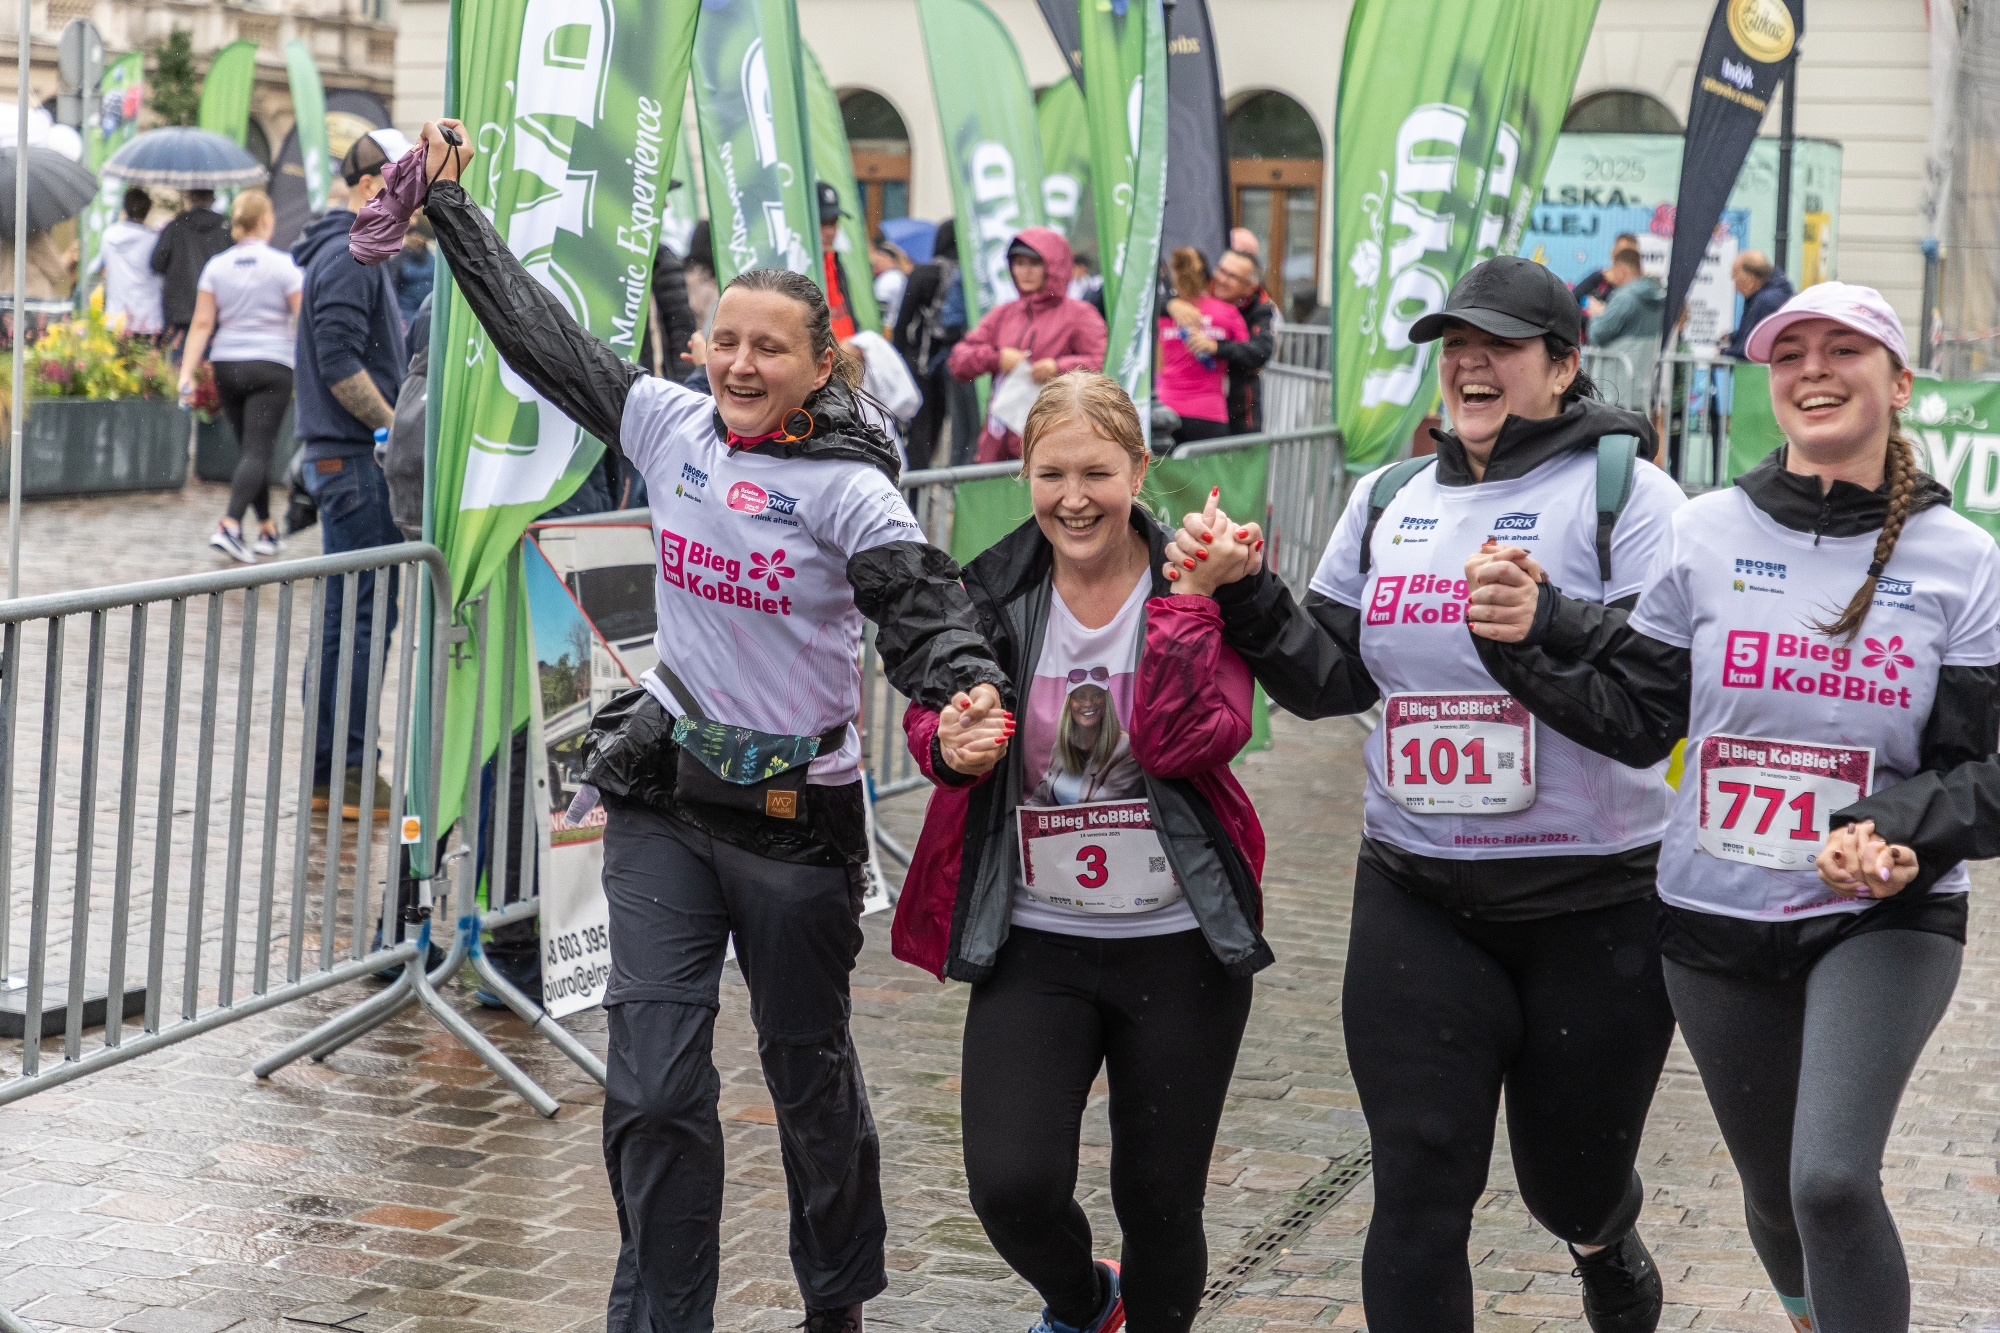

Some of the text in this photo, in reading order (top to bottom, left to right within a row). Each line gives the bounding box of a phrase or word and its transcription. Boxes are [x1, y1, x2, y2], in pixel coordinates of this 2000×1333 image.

[616, 96, 664, 257] Experience
[1583, 153, 1646, 183] 2025
[1361, 102, 1469, 408] LOYD
[767, 497, 795, 514] ORK
[772, 516, 800, 528] ahead.
[1496, 517, 1535, 528] TORK
[663, 536, 680, 568] 5
[687, 541, 741, 583] Bieg
[1735, 558, 1787, 573] BBOSiR
[664, 564, 681, 584] km
[1407, 573, 1470, 601] Bieg
[686, 571, 793, 616] KoBBiet
[1375, 581, 1398, 608] 5
[1875, 582, 1911, 594] ORK
[1370, 610, 1391, 623] km
[1401, 602, 1469, 624] KoB
[1887, 600, 1917, 612] ahead.
[1731, 637, 1759, 668] 5
[1775, 633, 1853, 672] Bieg
[1728, 669, 1757, 684] km
[1771, 666, 1912, 709] KoBBiet
[1409, 702, 1437, 719] Bieg
[1441, 701, 1500, 715] KoBBiet
[1401, 737, 1492, 785] 101
[1732, 745, 1767, 765] Bieg
[1770, 748, 1838, 770] KoBBiet
[1051, 815, 1084, 830] Bieg
[1088, 810, 1151, 825] KoBBiet
[1718, 780, 1821, 842] 771
[1454, 835, 1537, 845] Bielsko-Biała
[1539, 833, 1569, 843] 2025
[1075, 844, 1109, 889] 3
[558, 932, 582, 962] 603
[582, 924, 608, 954] 395
